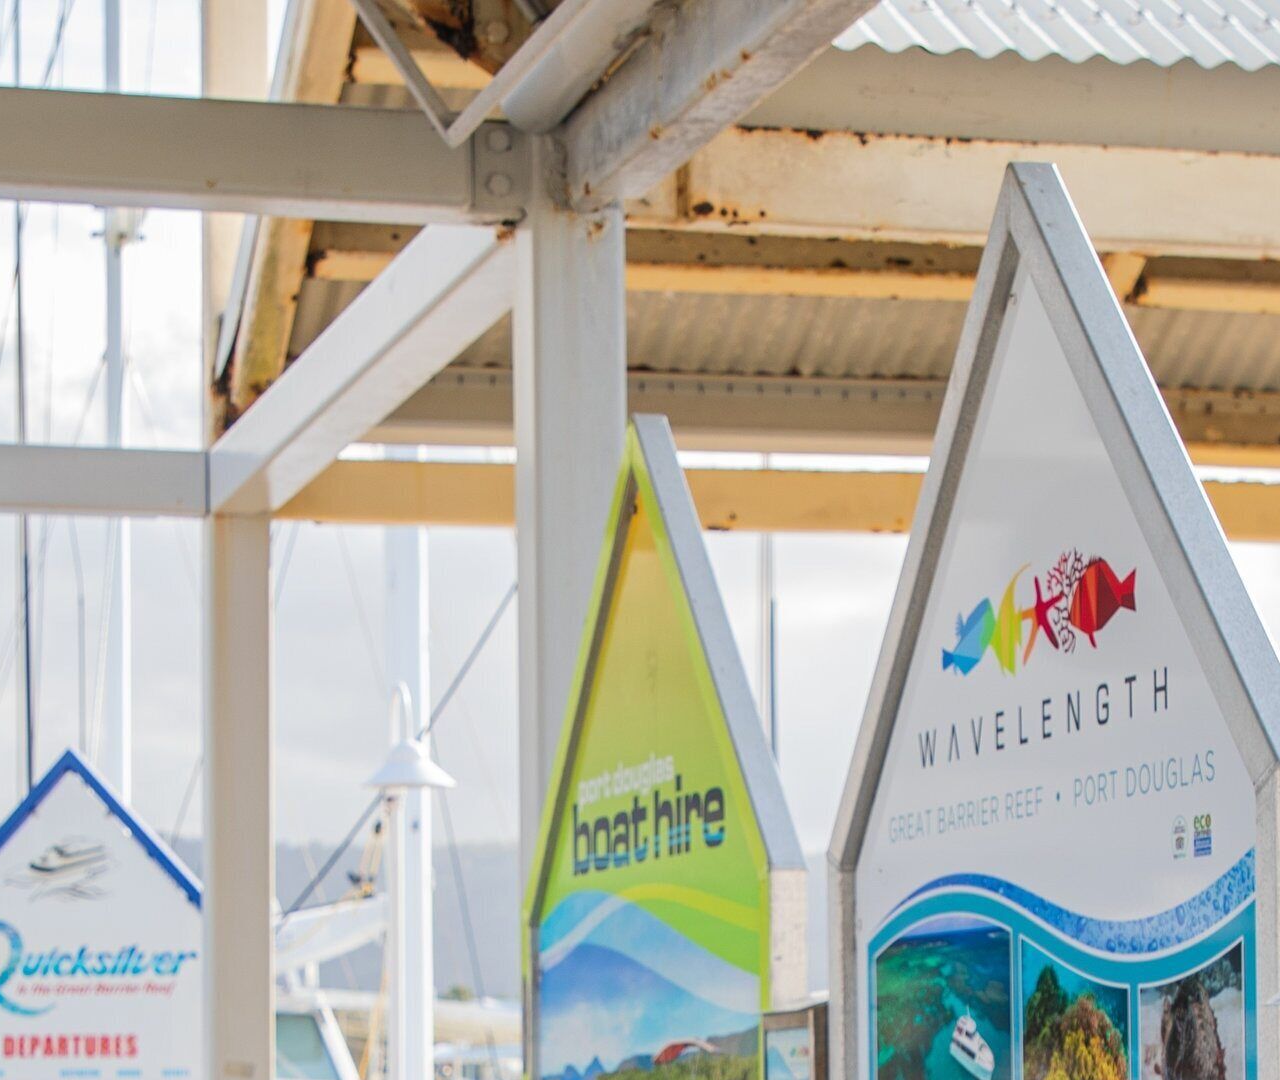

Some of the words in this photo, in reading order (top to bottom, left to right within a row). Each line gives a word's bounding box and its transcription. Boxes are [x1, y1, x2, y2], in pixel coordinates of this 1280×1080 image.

[918, 666, 1170, 769] WAVELENGTH
[573, 796, 649, 878] boat
[653, 774, 726, 860] hire
[888, 809, 932, 844] GREAT
[937, 795, 1000, 835] BARRIER
[1005, 786, 1044, 822] REEF
[1072, 769, 1119, 808] PORT
[1124, 750, 1216, 798] DOUGLAS
[3, 1034, 139, 1059] DEPARTURES
